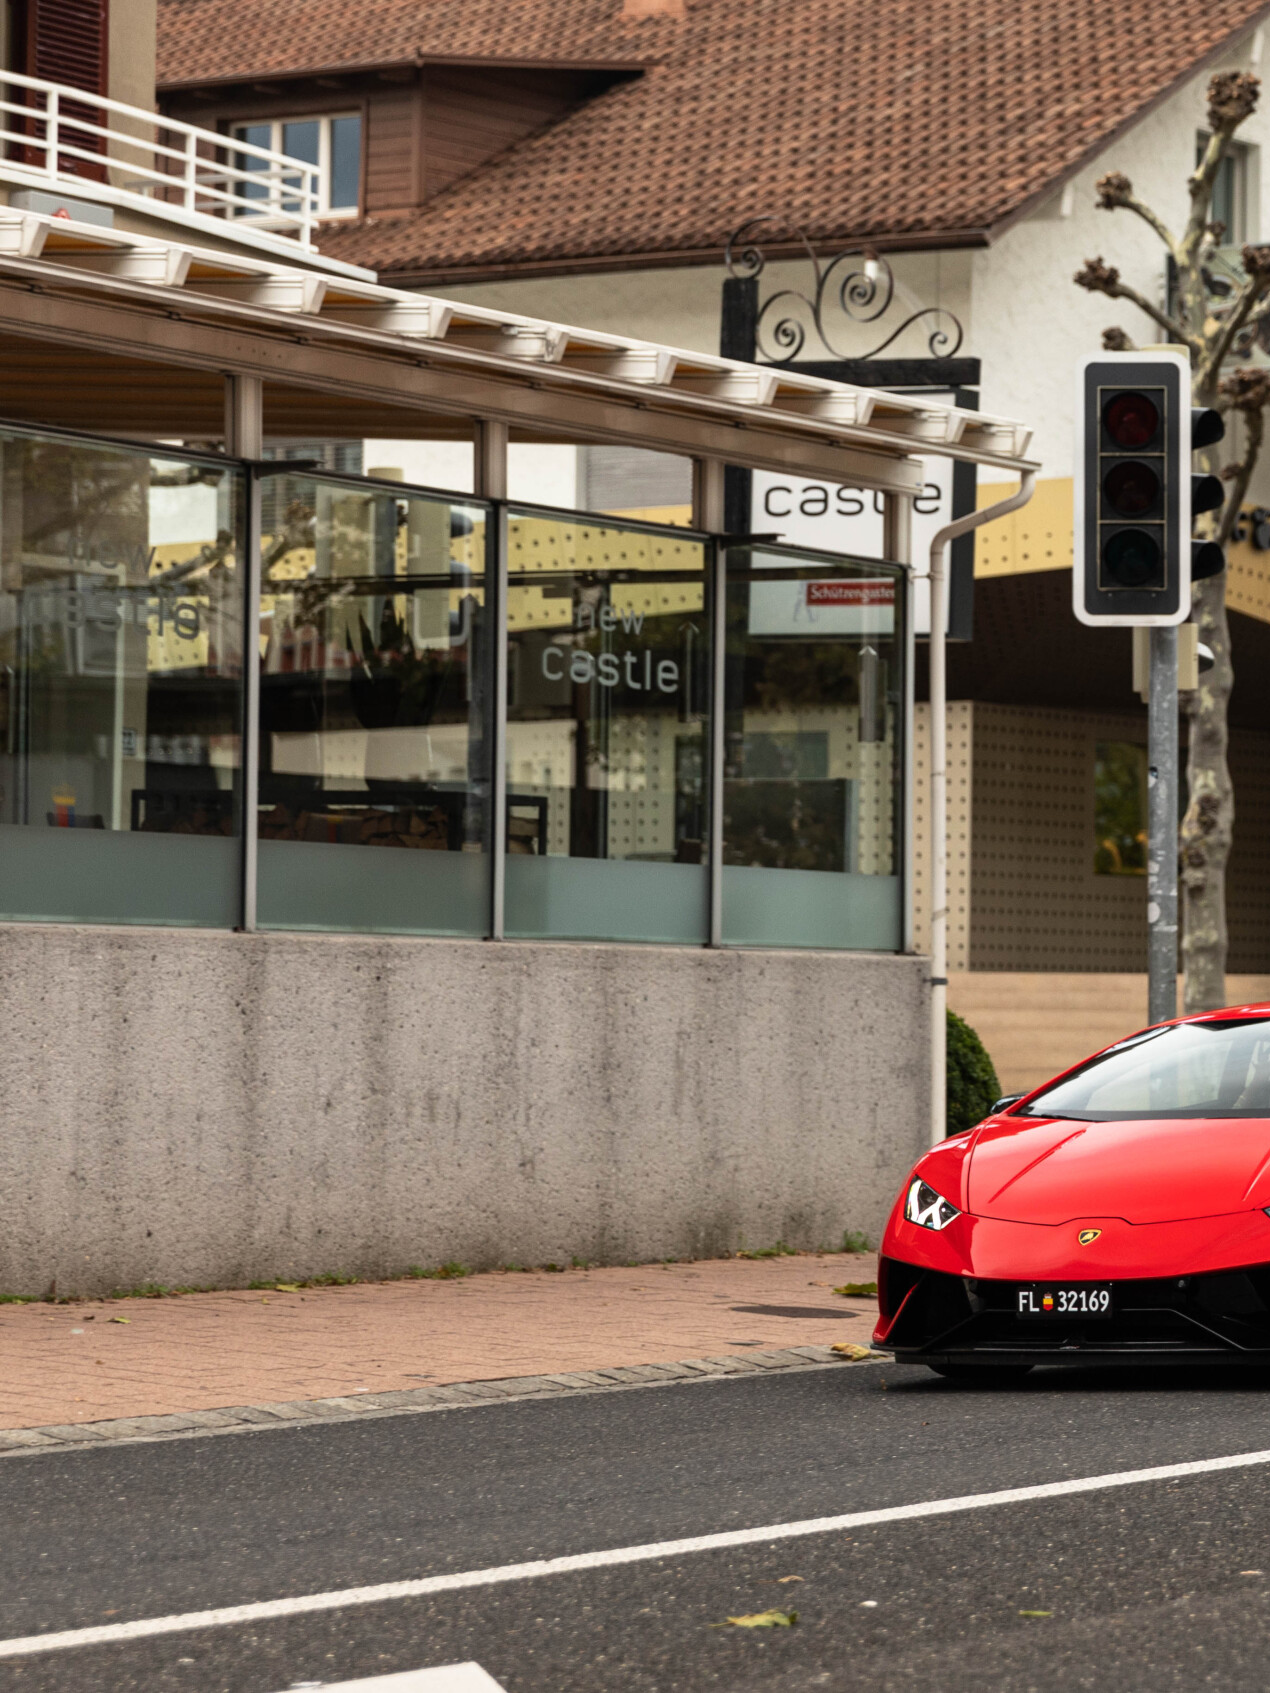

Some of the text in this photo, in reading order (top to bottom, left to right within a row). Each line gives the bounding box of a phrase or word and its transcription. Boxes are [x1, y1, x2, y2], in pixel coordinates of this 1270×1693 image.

[764, 483, 942, 517] case
[576, 603, 645, 635] new
[541, 647, 680, 694] castle
[1019, 1290, 1110, 1312] FL 32169
